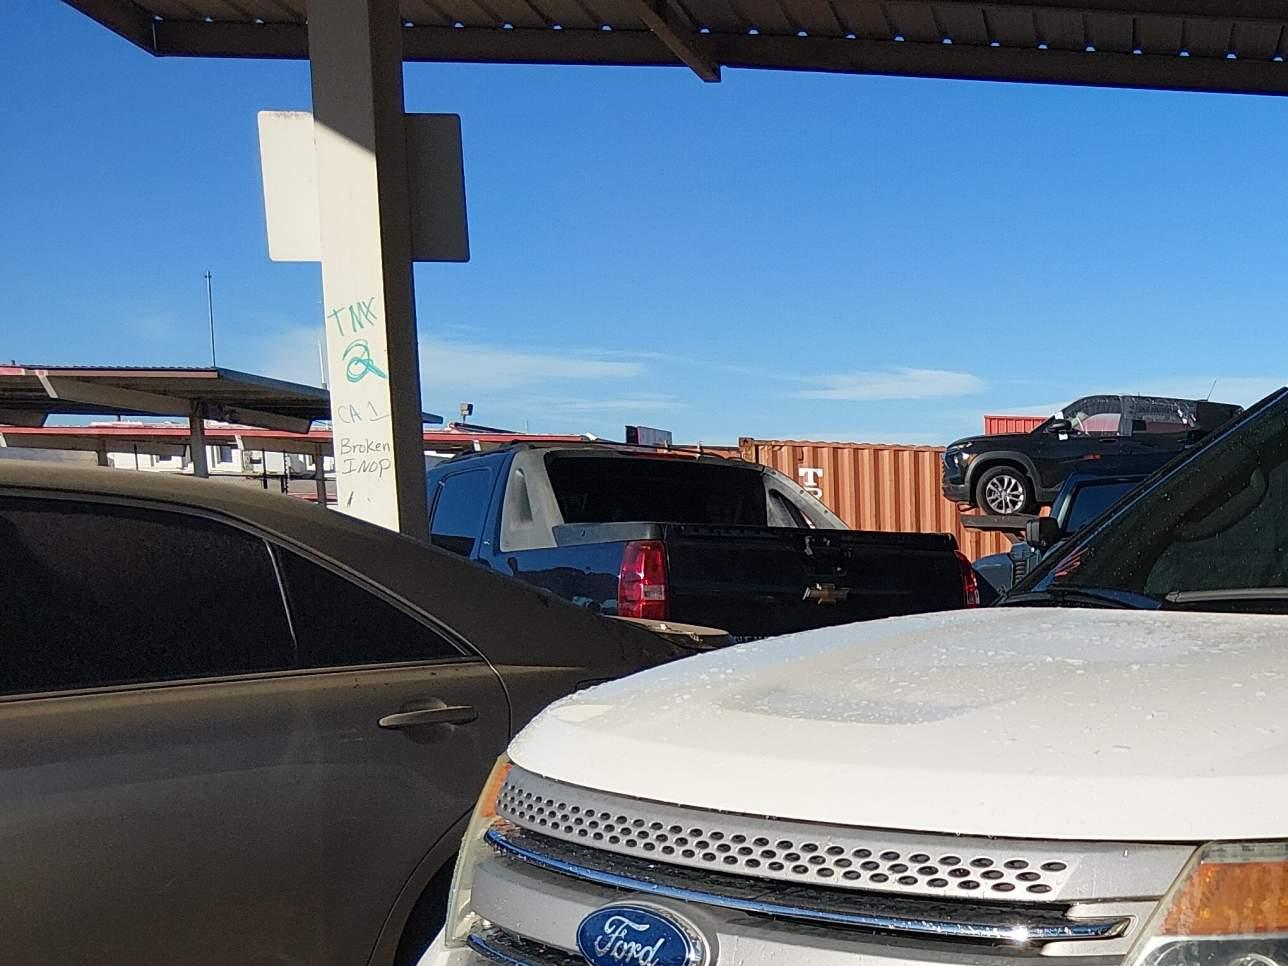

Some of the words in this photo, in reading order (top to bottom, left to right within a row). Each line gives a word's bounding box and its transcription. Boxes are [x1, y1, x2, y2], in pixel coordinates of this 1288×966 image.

[342, 338, 388, 383] 2
[340, 439, 391, 456] Broken
[341, 458, 392, 478] INOP
